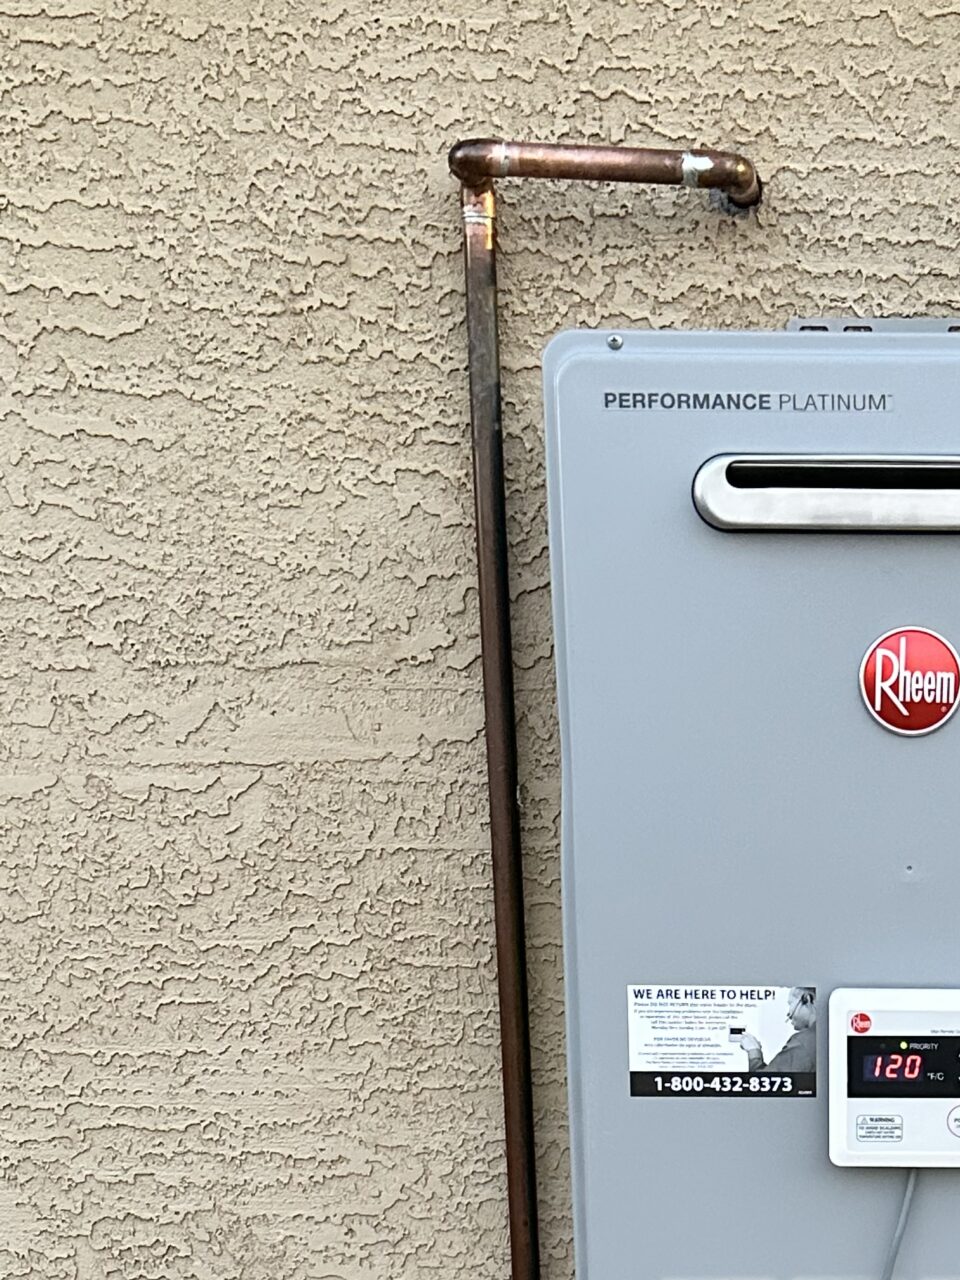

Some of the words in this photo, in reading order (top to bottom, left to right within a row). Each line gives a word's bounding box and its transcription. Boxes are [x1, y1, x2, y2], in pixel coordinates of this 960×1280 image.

[603, 392, 772, 411] PERFORMANCE
[874, 635, 955, 717] Rheem
[633, 988, 652, 1000] WE
[656, 988, 680, 1000] ARE
[684, 989, 717, 1000] HERE
[720, 989, 737, 1001] TO
[740, 989, 776, 1001] HELP!
[909, 1042, 939, 1050] PRIORITY
[874, 1054, 921, 1079] 120
[653, 1076, 793, 1093] 1-800-432-8373
